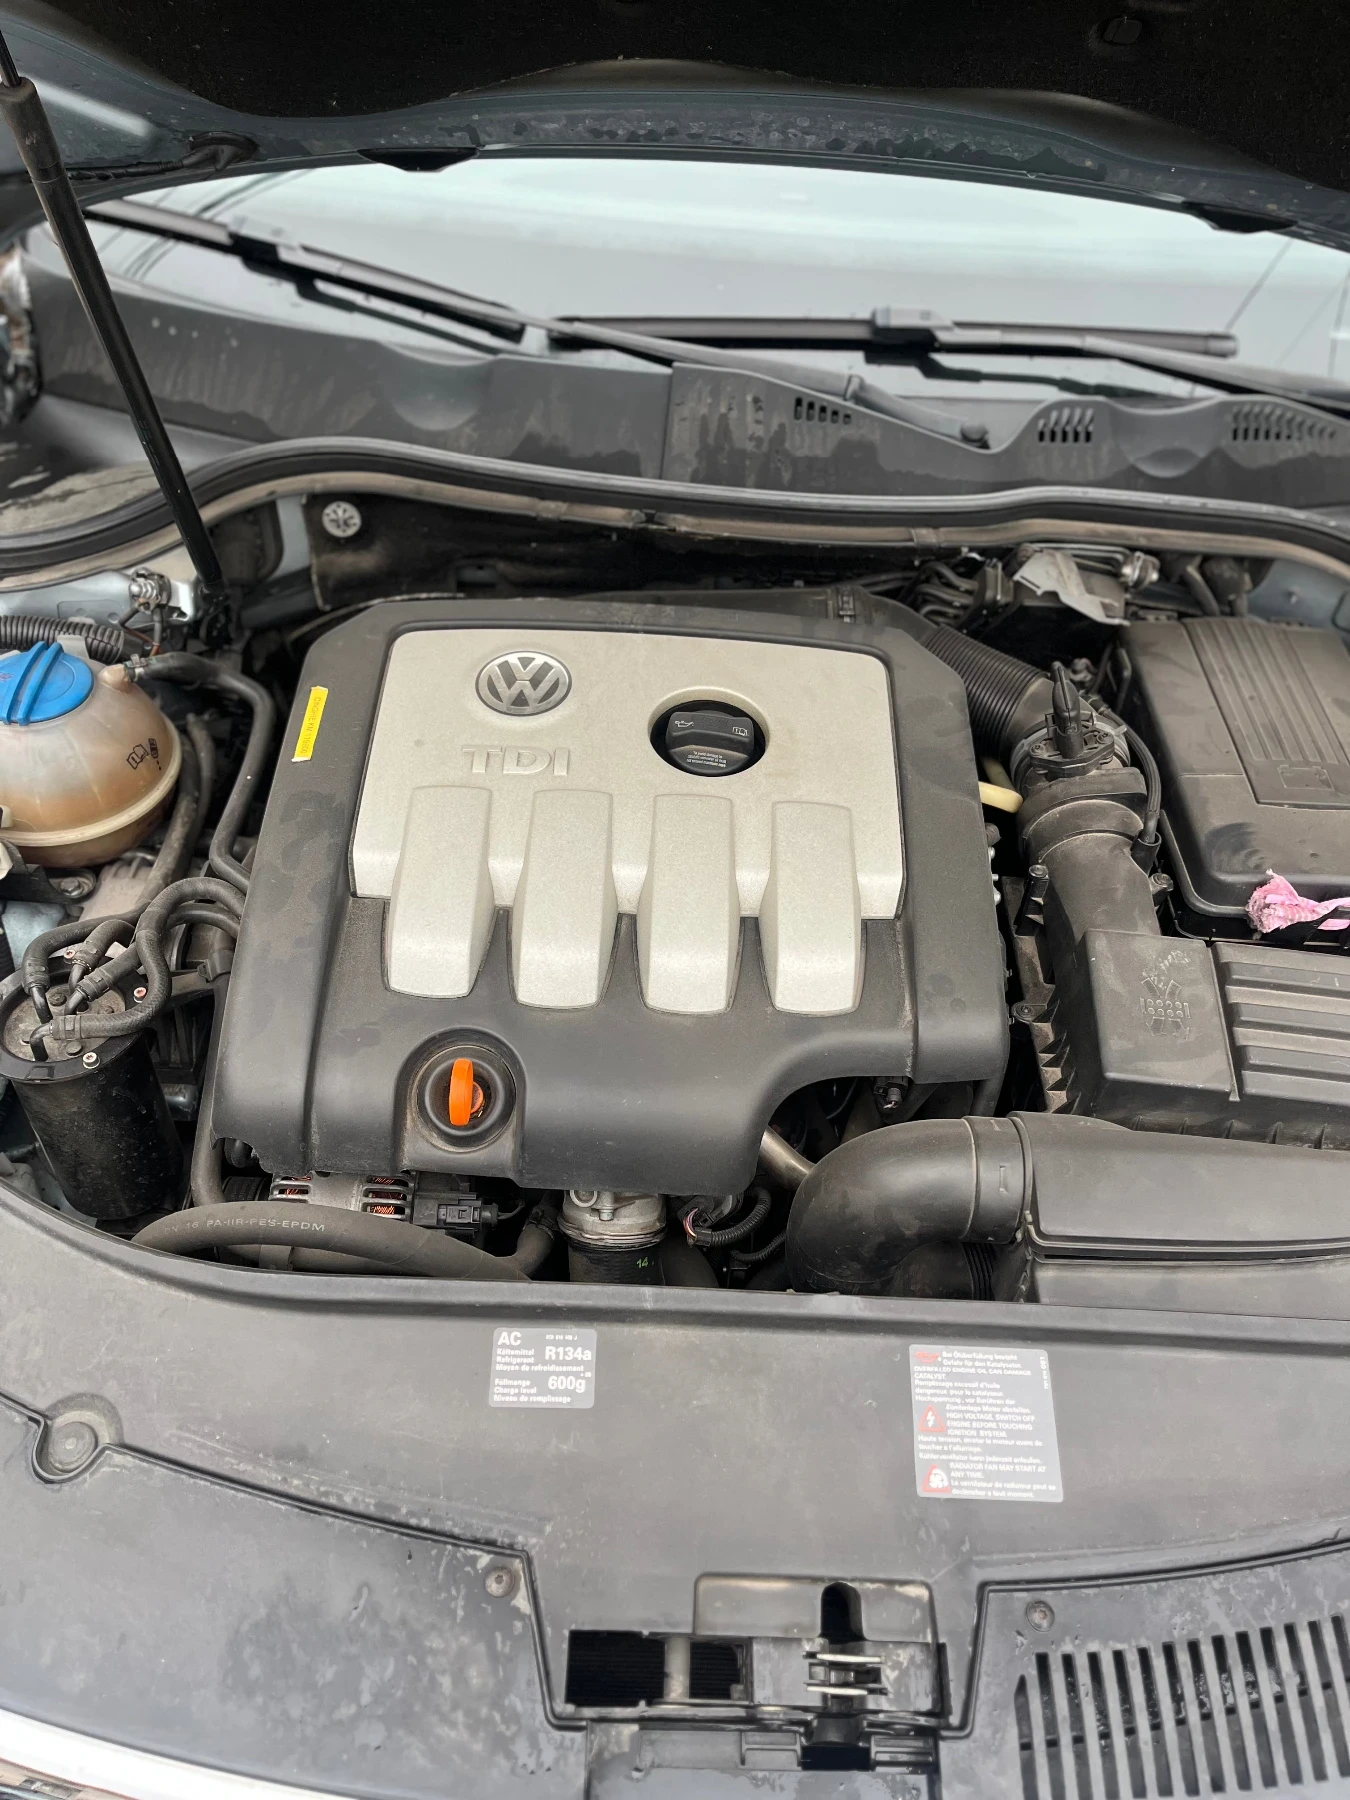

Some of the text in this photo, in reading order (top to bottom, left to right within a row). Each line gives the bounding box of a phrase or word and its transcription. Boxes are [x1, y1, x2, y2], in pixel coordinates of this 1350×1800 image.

[461, 745, 570, 776] TDI
[186, 1221, 199, 1229] 16
[497, 1331, 522, 1346] AC
[496, 1348, 535, 1356] Kältemittel
[544, 1345, 592, 1361] R134a
[496, 1355, 535, 1365] Refrigerant
[495, 1363, 585, 1372] Moyen de refroidissement
[494, 1378, 531, 1387] Füllmenge
[547, 1375, 586, 1394] 600g
[494, 1386, 537, 1395] Charge level
[493, 1394, 571, 1403] Niveau de remplissage
[972, 1421, 998, 1429] BEFORE
[998, 1422, 1033, 1431] TOUCHING
[948, 1429, 977, 1437] IGNITION
[950, 1462, 984, 1470] RADIATOR
[985, 1463, 998, 1471] FAN
[951, 1470, 965, 1478] ANY
